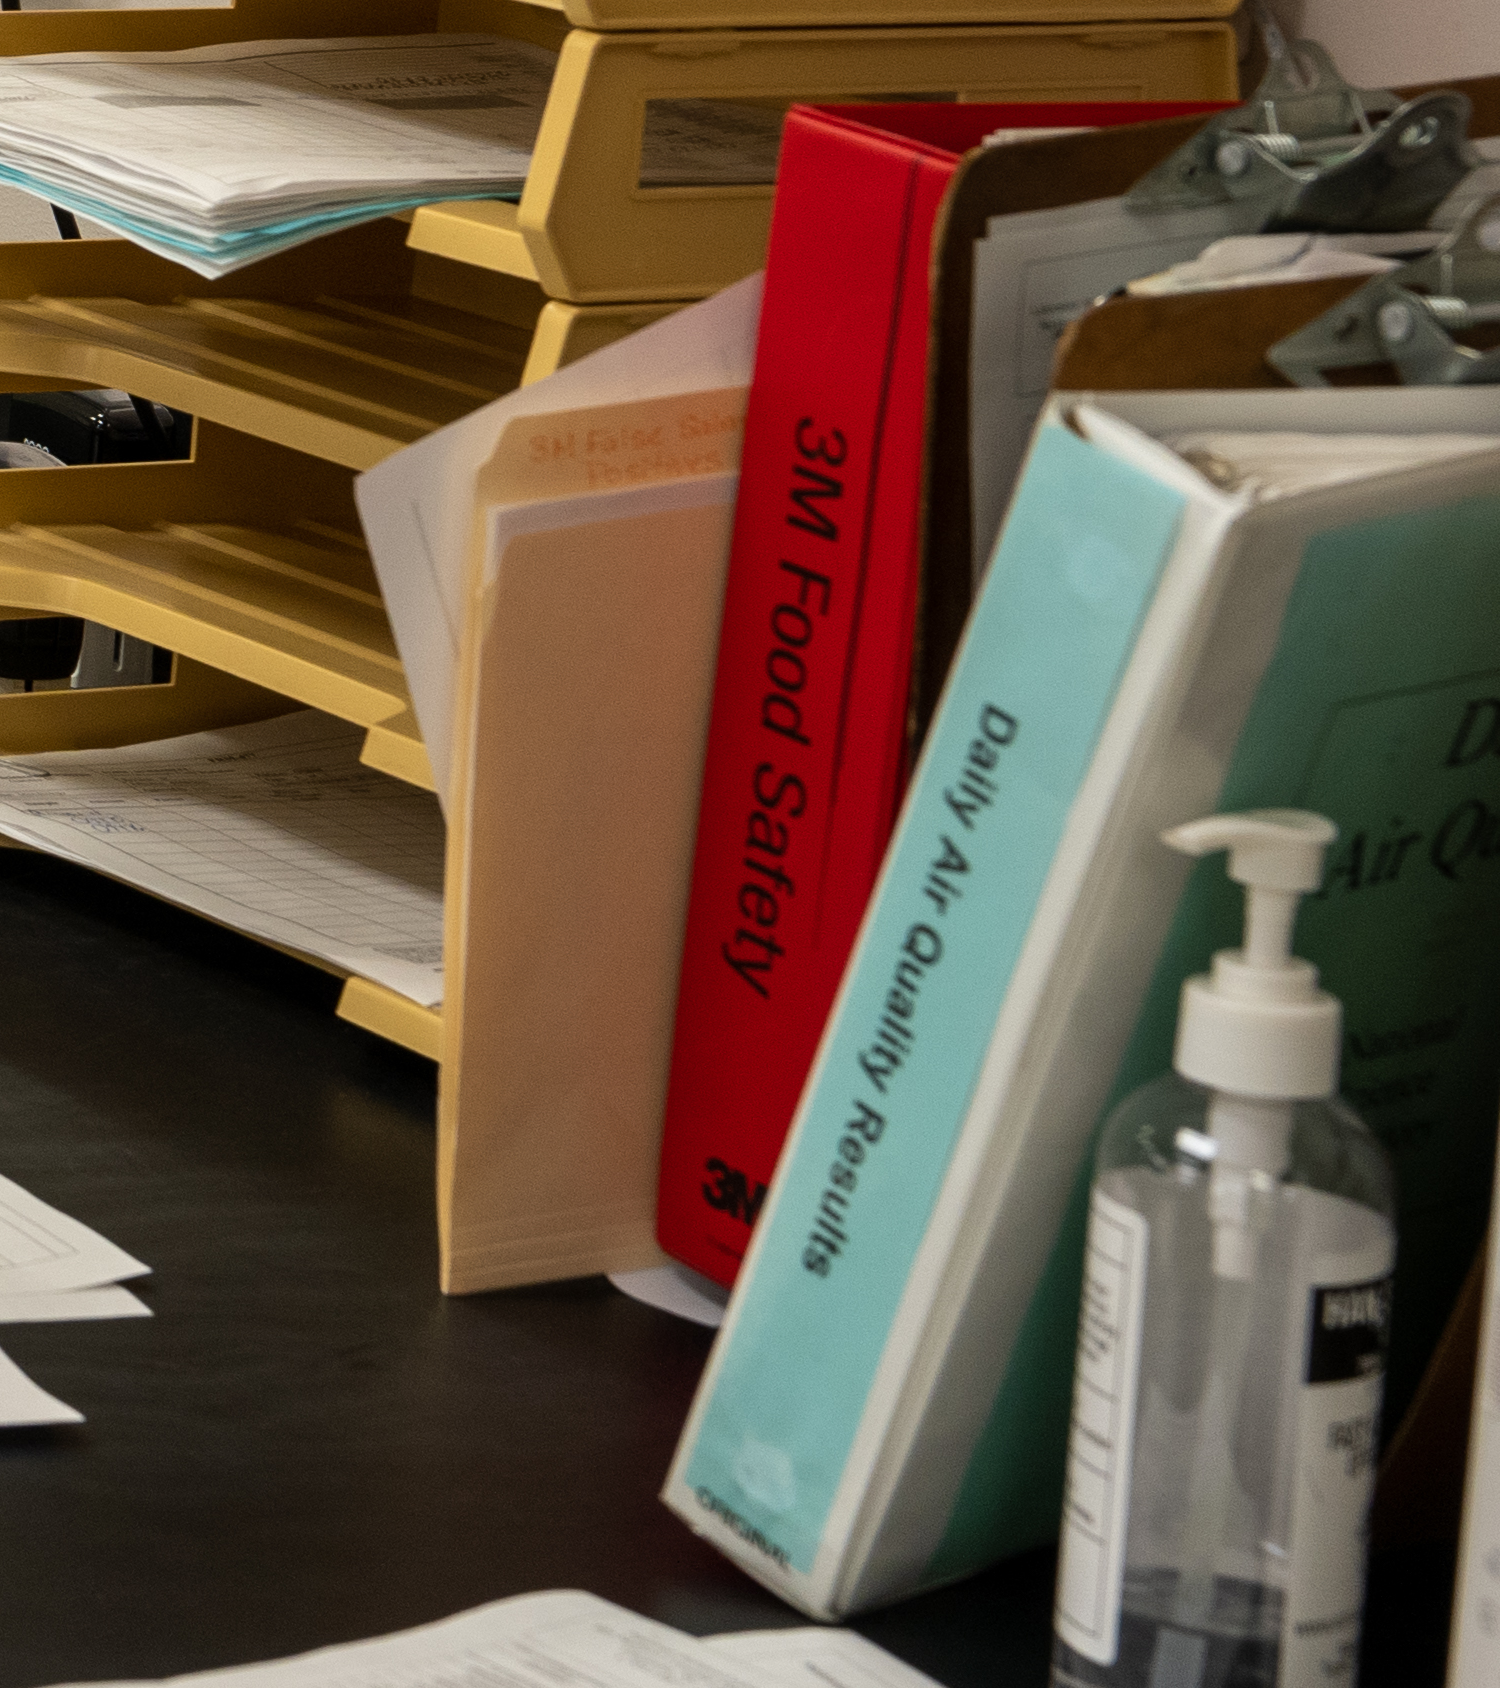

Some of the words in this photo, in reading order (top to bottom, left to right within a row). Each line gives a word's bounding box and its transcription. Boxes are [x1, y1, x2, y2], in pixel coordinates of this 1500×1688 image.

[788, 417, 849, 542] 3M
[761, 559, 832, 746] Food
[942, 706, 1019, 831] Daily
[721, 762, 808, 1001] Safety
[921, 835, 973, 917] Air
[857, 921, 944, 1097] Quality
[801, 1098, 885, 1279] Results
